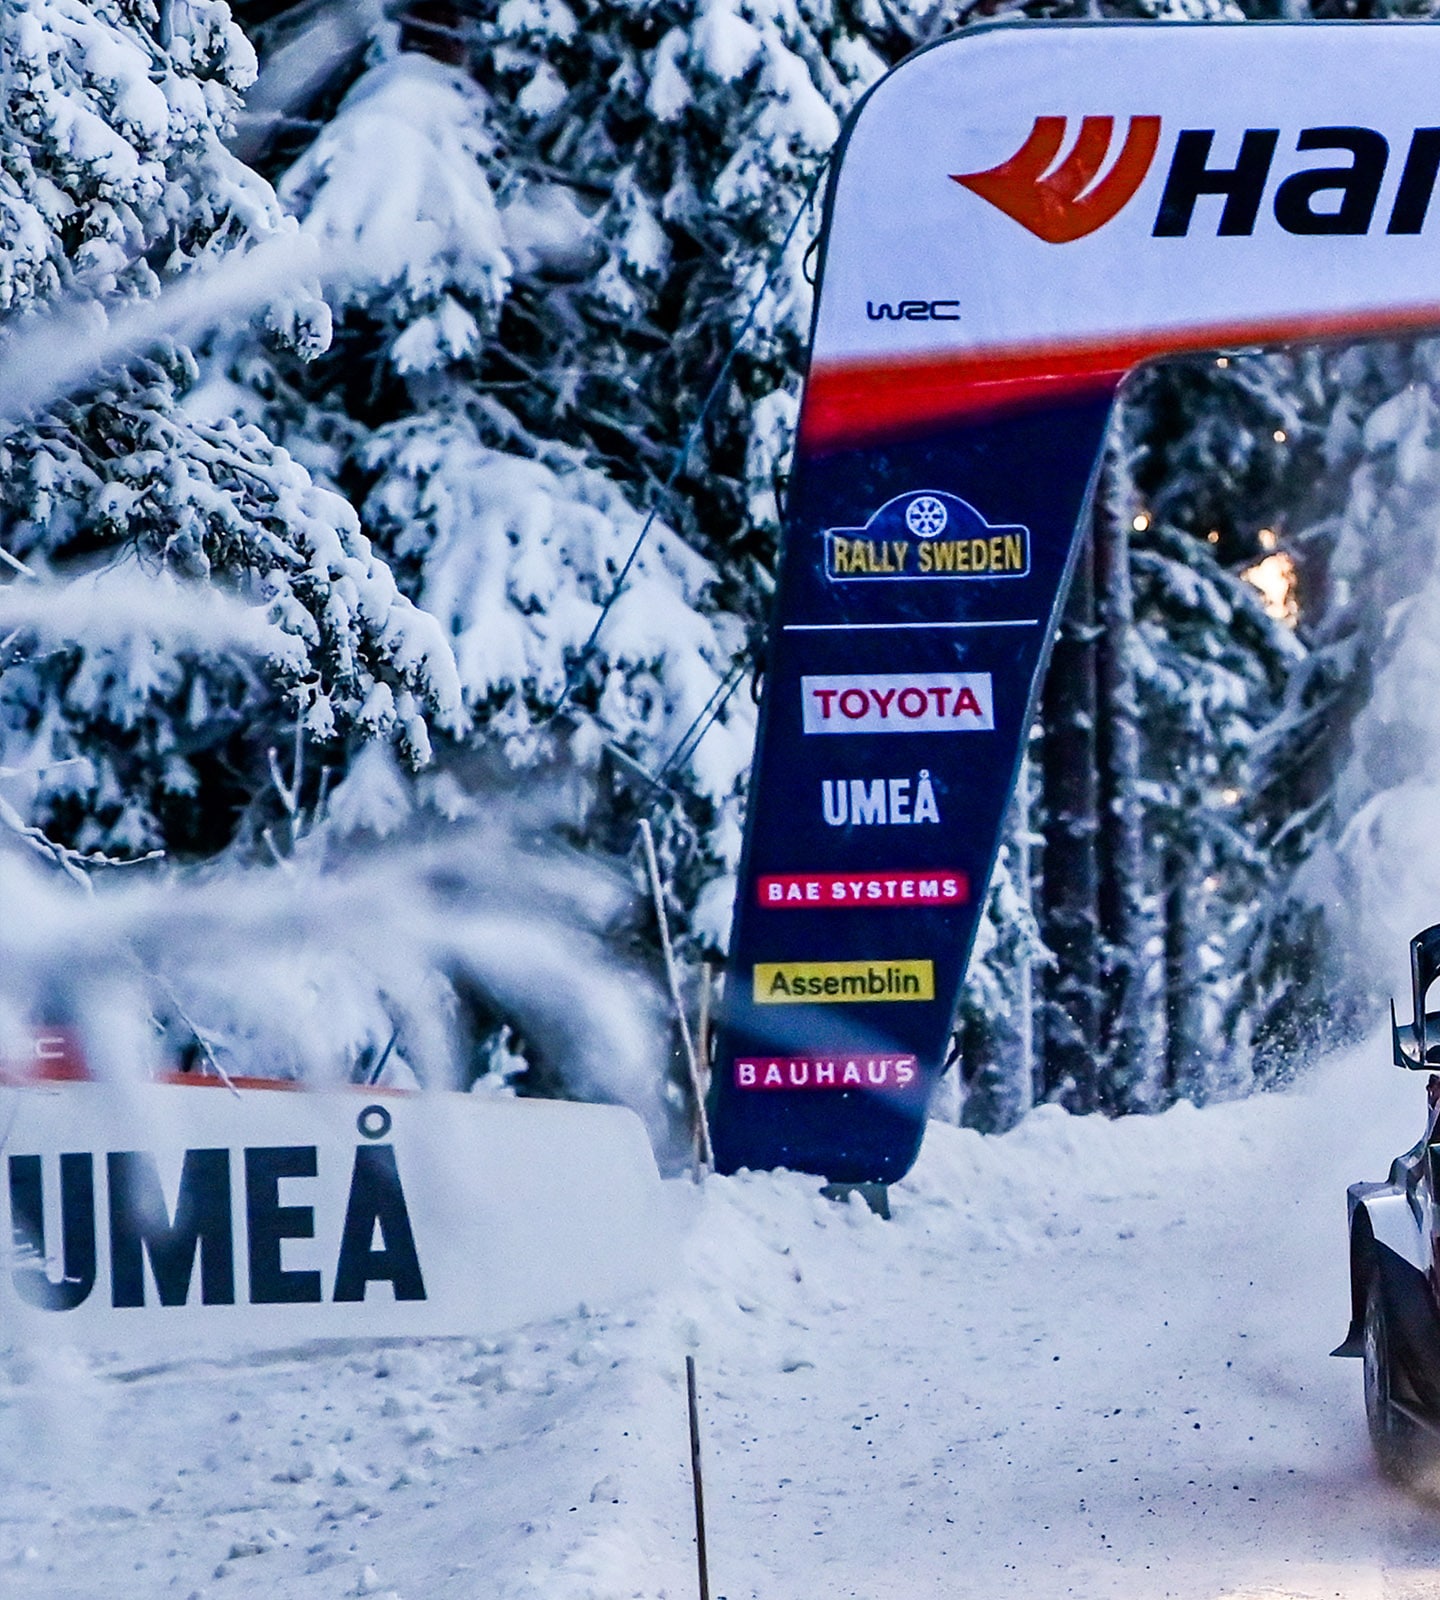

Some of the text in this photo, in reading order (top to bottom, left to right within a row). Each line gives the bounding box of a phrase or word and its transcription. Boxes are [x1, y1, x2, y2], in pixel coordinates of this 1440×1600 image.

[866, 300, 961, 321] WRC
[833, 533, 1023, 573] RALLY SWEDEN
[813, 687, 983, 720] TOYOTA
[822, 769, 940, 826] UMEÅ
[767, 879, 958, 901] BAE SYSTEMS
[769, 968, 921, 996] Assemblin
[738, 1059, 915, 1087] BAUHAUS
[8, 1104, 428, 1312] UMEÅ
